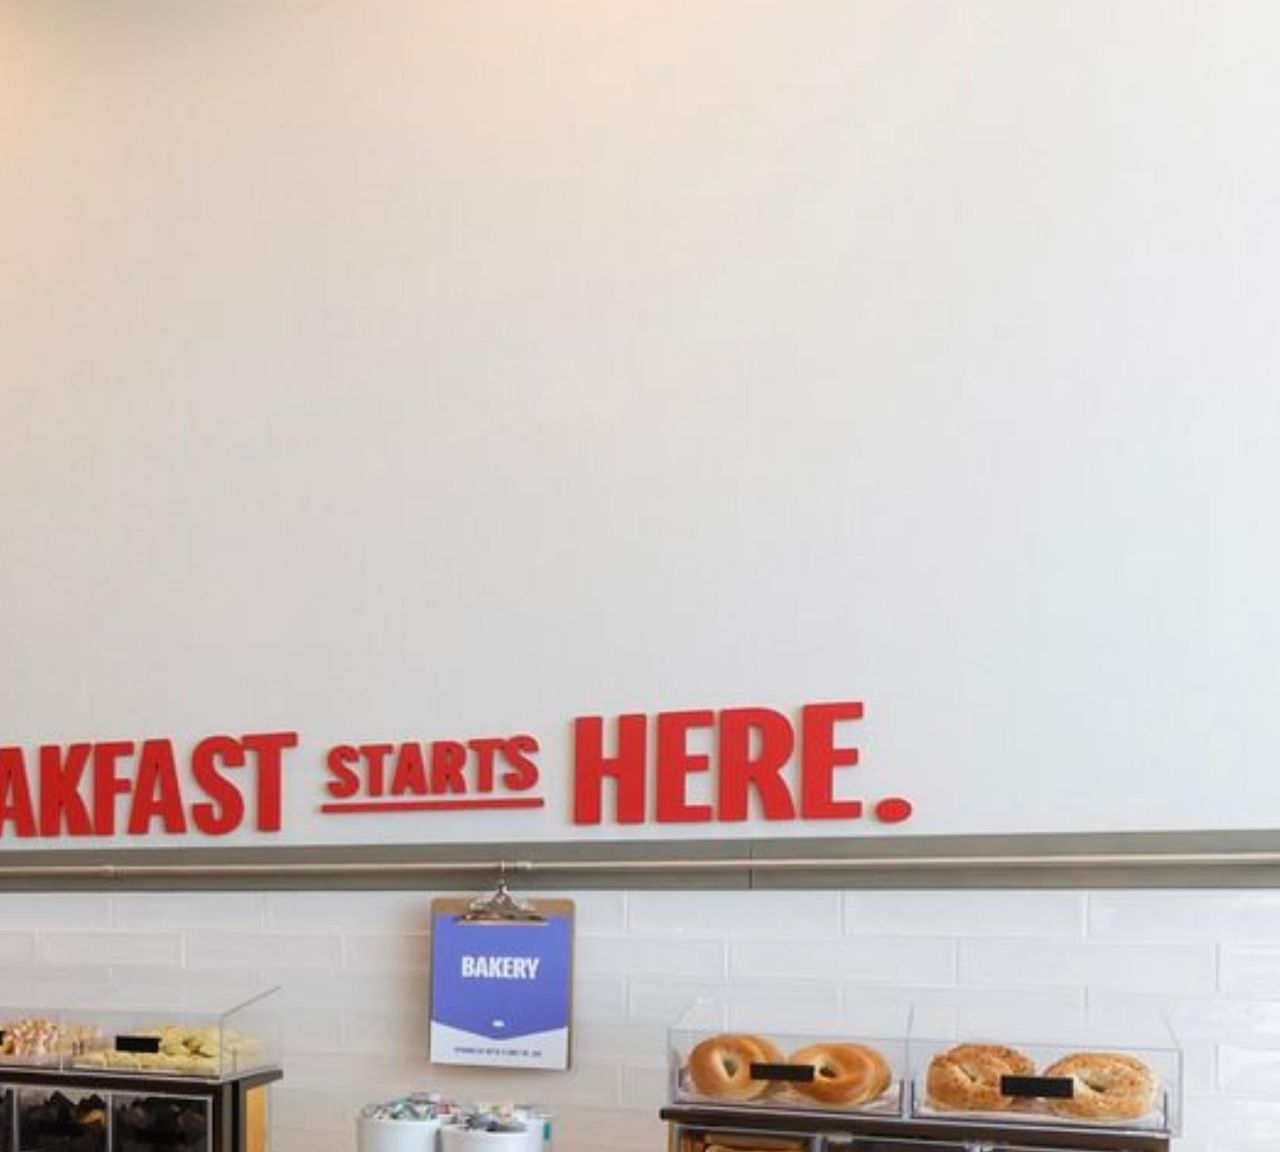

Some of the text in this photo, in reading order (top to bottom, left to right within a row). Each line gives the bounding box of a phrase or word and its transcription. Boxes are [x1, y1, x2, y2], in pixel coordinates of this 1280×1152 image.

[325, 734, 541, 800] STARTS
[571, 700, 913, 826] HERE.
[460, 955, 541, 980] BAKERY
